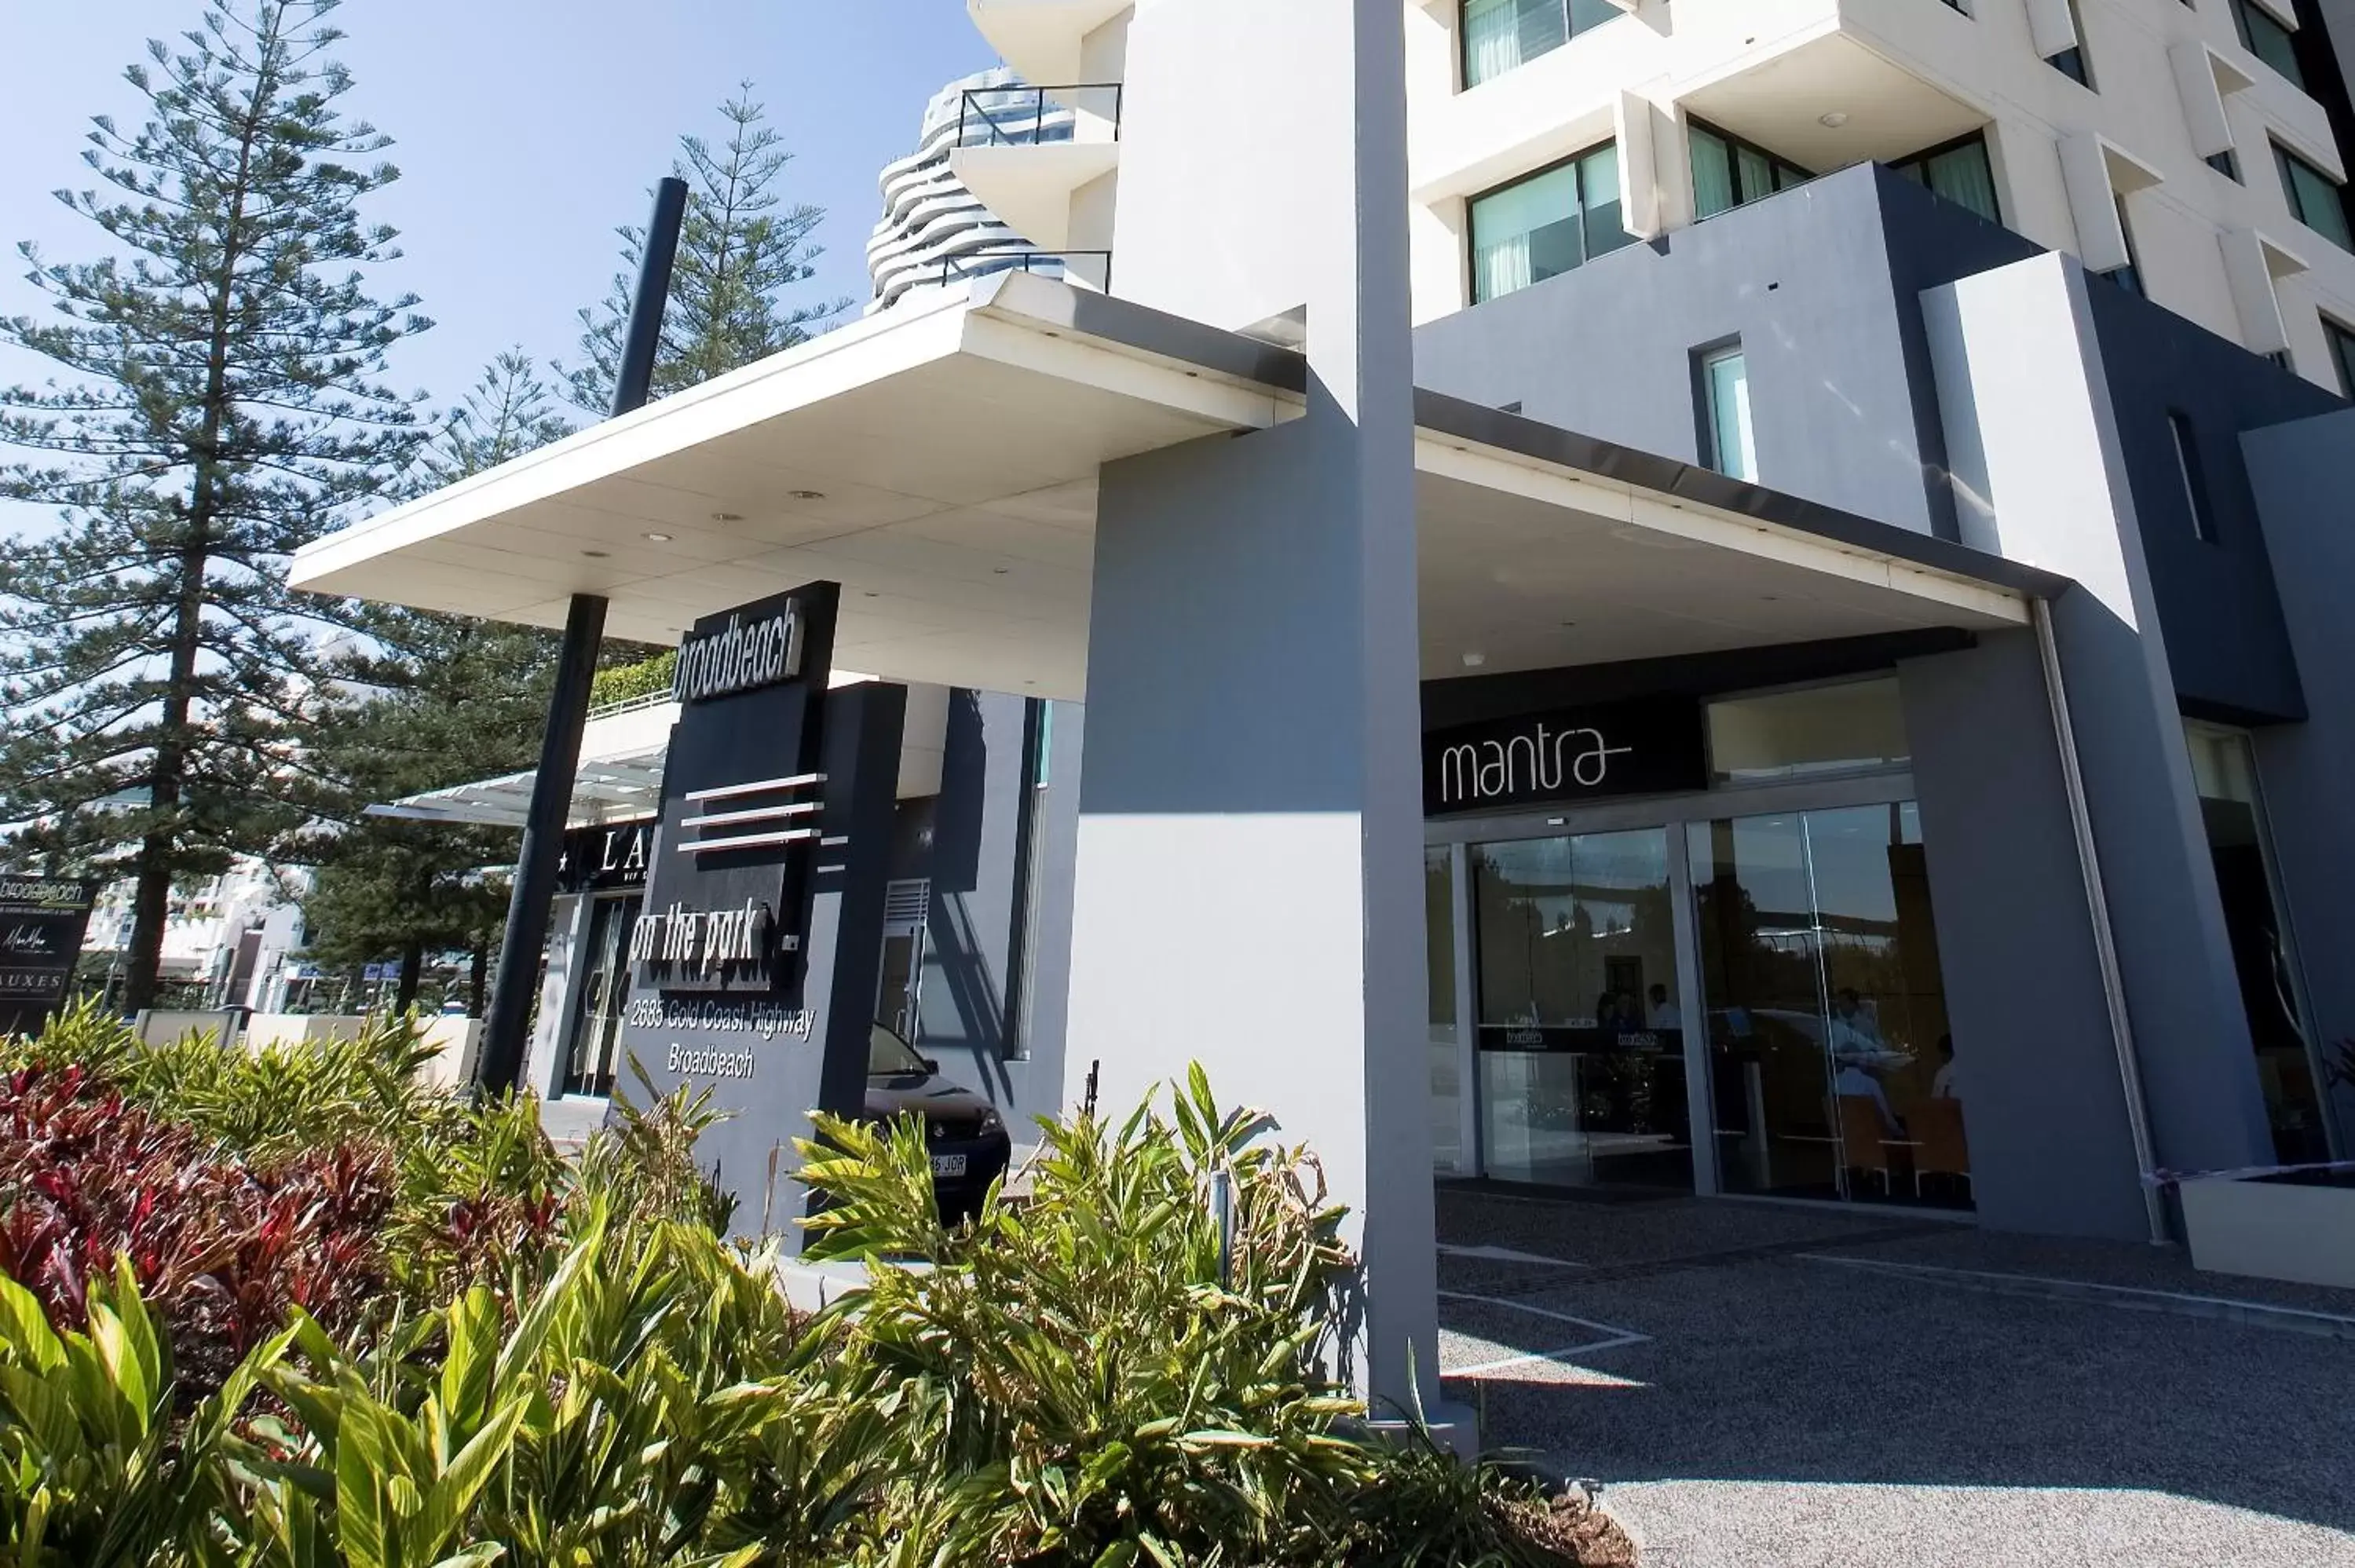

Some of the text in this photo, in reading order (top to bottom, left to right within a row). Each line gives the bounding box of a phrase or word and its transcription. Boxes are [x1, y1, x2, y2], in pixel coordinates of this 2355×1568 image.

[671, 597, 799, 701] broadbeach
[1442, 722, 1632, 802] mantra
[630, 914, 657, 961] on
[662, 902, 697, 961] the
[631, 999, 815, 1041] 2685 Gold Coast Highway
[668, 1043, 755, 1078] Broadbeach
